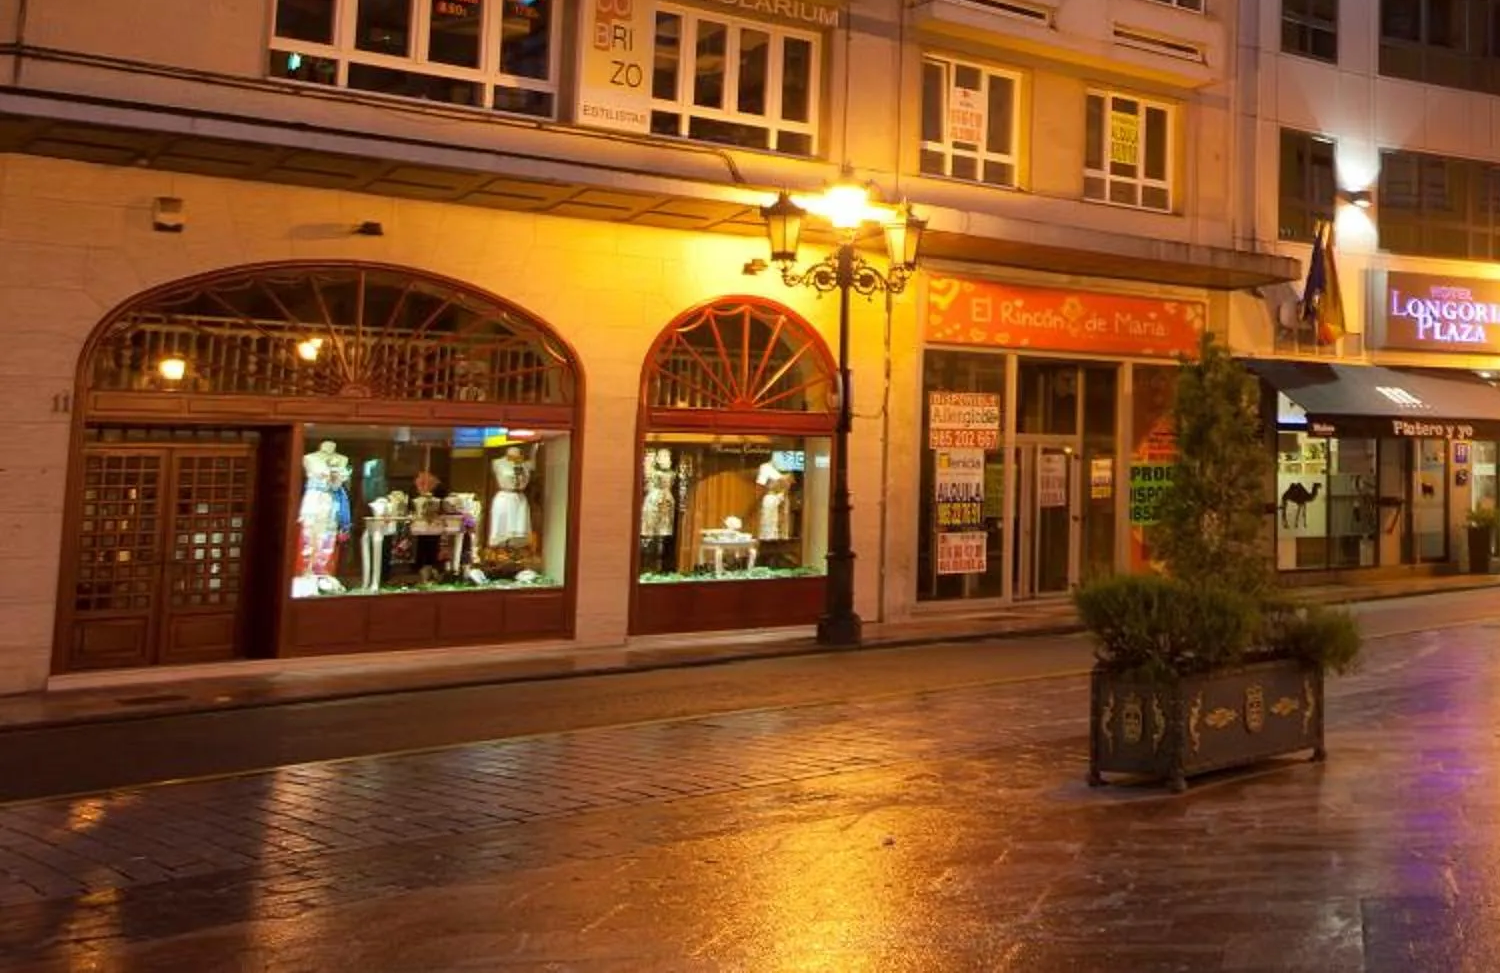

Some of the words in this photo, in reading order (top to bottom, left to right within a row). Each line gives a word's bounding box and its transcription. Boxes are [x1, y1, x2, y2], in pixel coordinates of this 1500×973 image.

[609, 59, 643, 89] ZO
[582, 103, 647, 126] ESTILISTAS
[971, 298, 992, 323] El
[1085, 314, 1107, 332] de
[1416, 313, 1487, 342] PLAZA
[1393, 420, 1441, 436] Platero
[1457, 424, 1473, 438] yo
